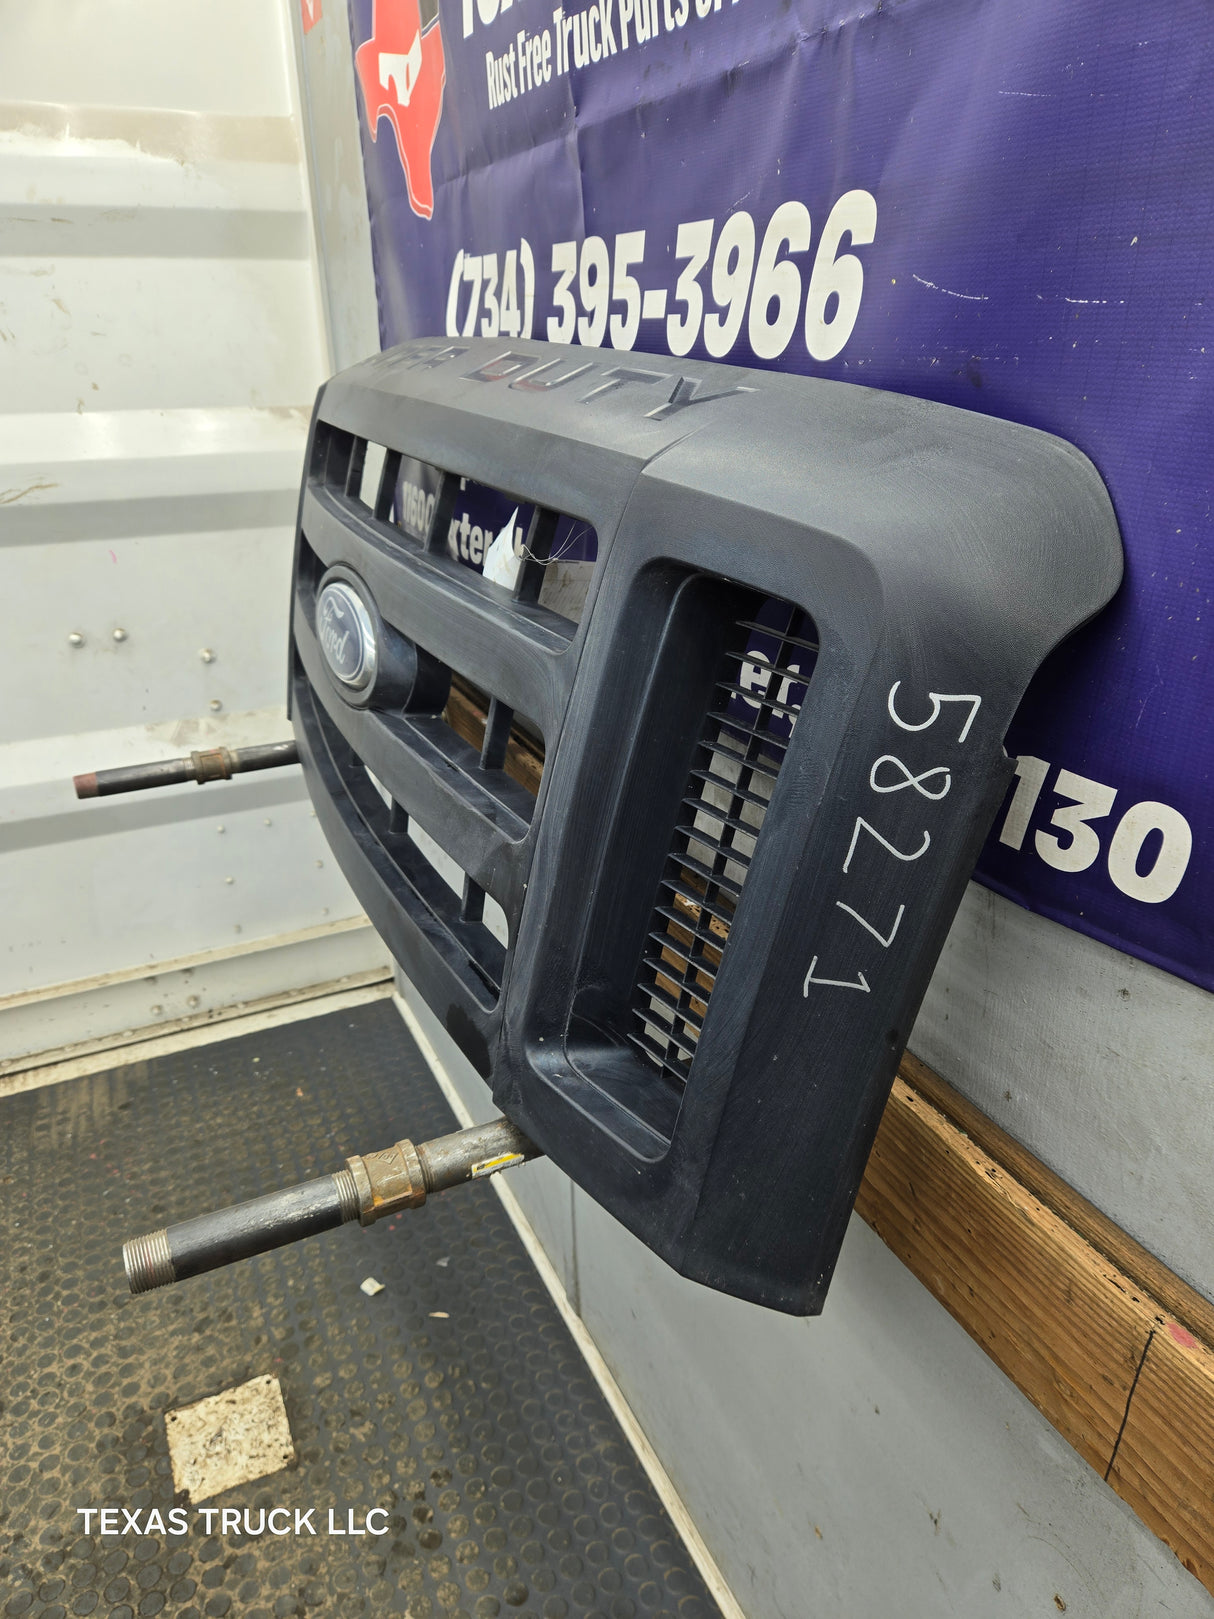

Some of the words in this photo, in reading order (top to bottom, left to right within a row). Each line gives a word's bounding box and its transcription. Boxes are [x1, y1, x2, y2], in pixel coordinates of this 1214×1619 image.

[486, 51, 518, 110] Rust
[517, 29, 552, 95] Free
[553, 0, 618, 76] Truck
[446, 237, 535, 338] (734)
[547, 189, 878, 361] 395-3966
[458, 350, 761, 421] DUTY
[447, 512, 494, 567] xter
[320, 596, 352, 664] Ford
[804, 681, 982, 999] 58271
[1000, 745, 1193, 904] 130
